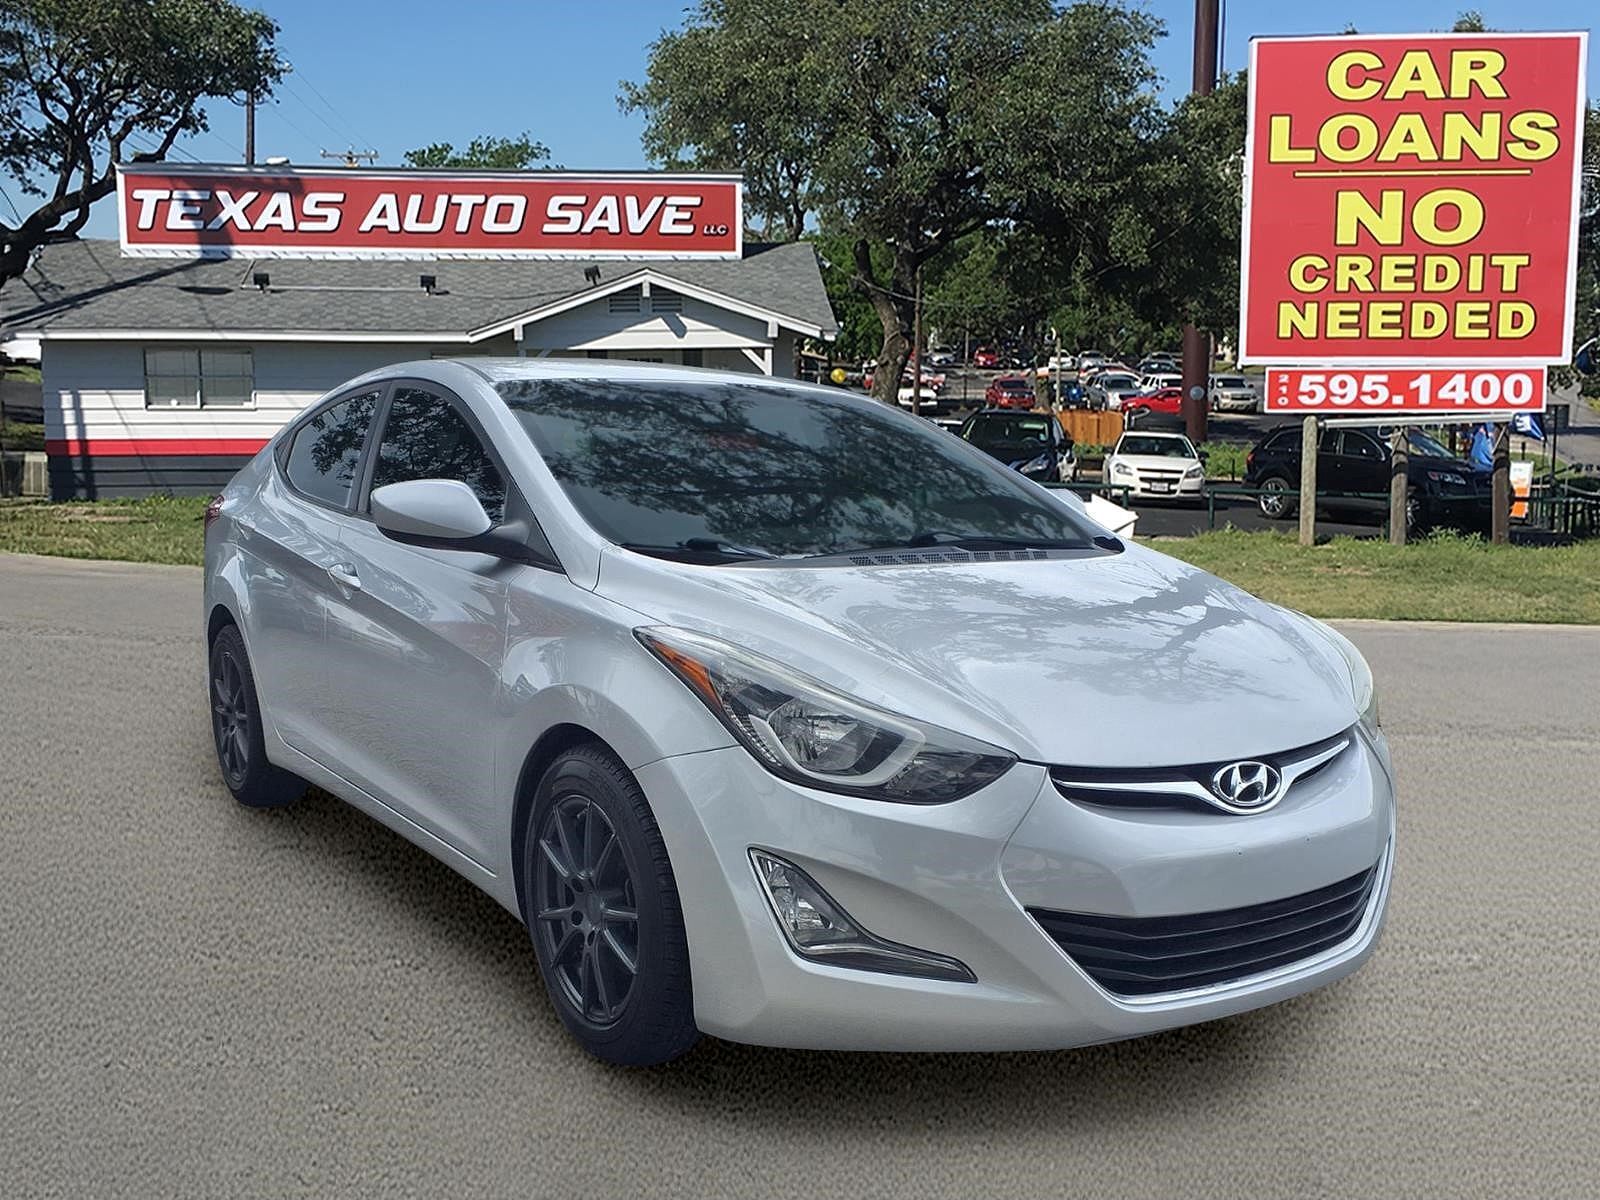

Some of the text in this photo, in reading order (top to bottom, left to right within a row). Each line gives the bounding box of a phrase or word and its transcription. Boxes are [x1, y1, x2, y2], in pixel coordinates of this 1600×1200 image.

[1326, 50, 1508, 101] CAR
[1268, 111, 1560, 163] LOANS
[131, 188, 729, 235] TEXAS AUTO SAVE LLC
[1335, 188, 1485, 246] NO
[1289, 254, 1530, 293] CREDIT
[1277, 301, 1536, 339] NEEDED
[1297, 373, 1534, 406] 595.1400
